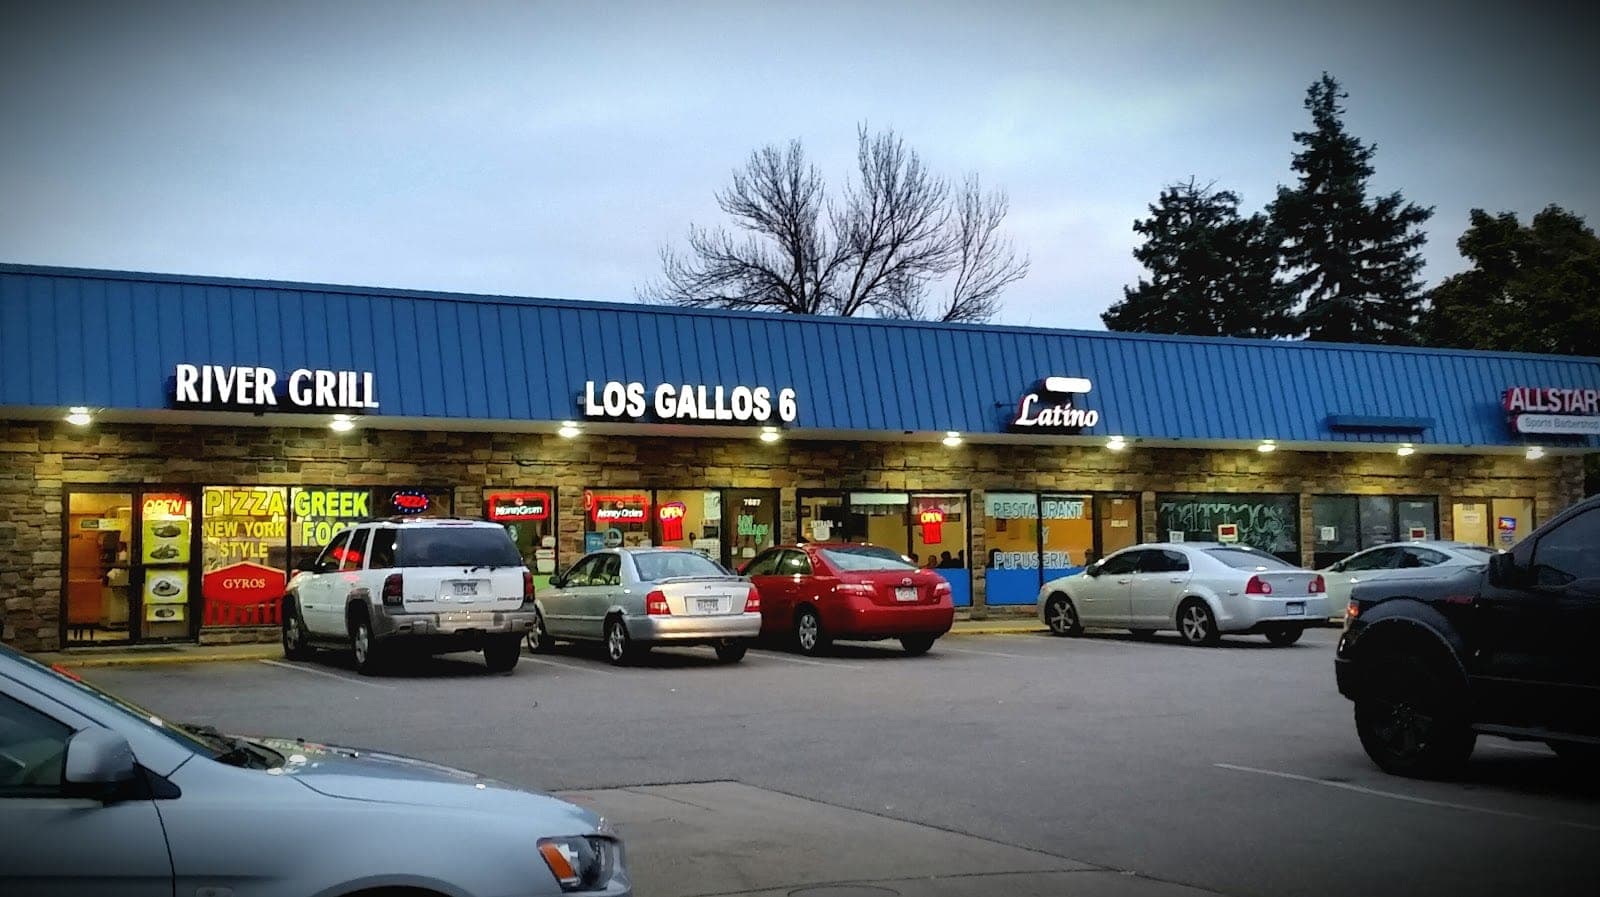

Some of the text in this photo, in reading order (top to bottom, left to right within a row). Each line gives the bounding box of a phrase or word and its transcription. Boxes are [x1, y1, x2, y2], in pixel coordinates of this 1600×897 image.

[176, 364, 380, 408] RIVER GRILL
[585, 381, 797, 422] LOS GALLOS 6
[1014, 393, 1099, 427] Latino
[143, 500, 182, 514] OPEN
[205, 490, 285, 516] PIZZA
[294, 491, 369, 517] GREEK
[993, 502, 1084, 520] RESTAURANT
[660, 507, 683, 519] OPEN
[204, 521, 285, 537] NEW YORK
[221, 541, 268, 558] STYLE
[223, 578, 265, 589] GYROS
